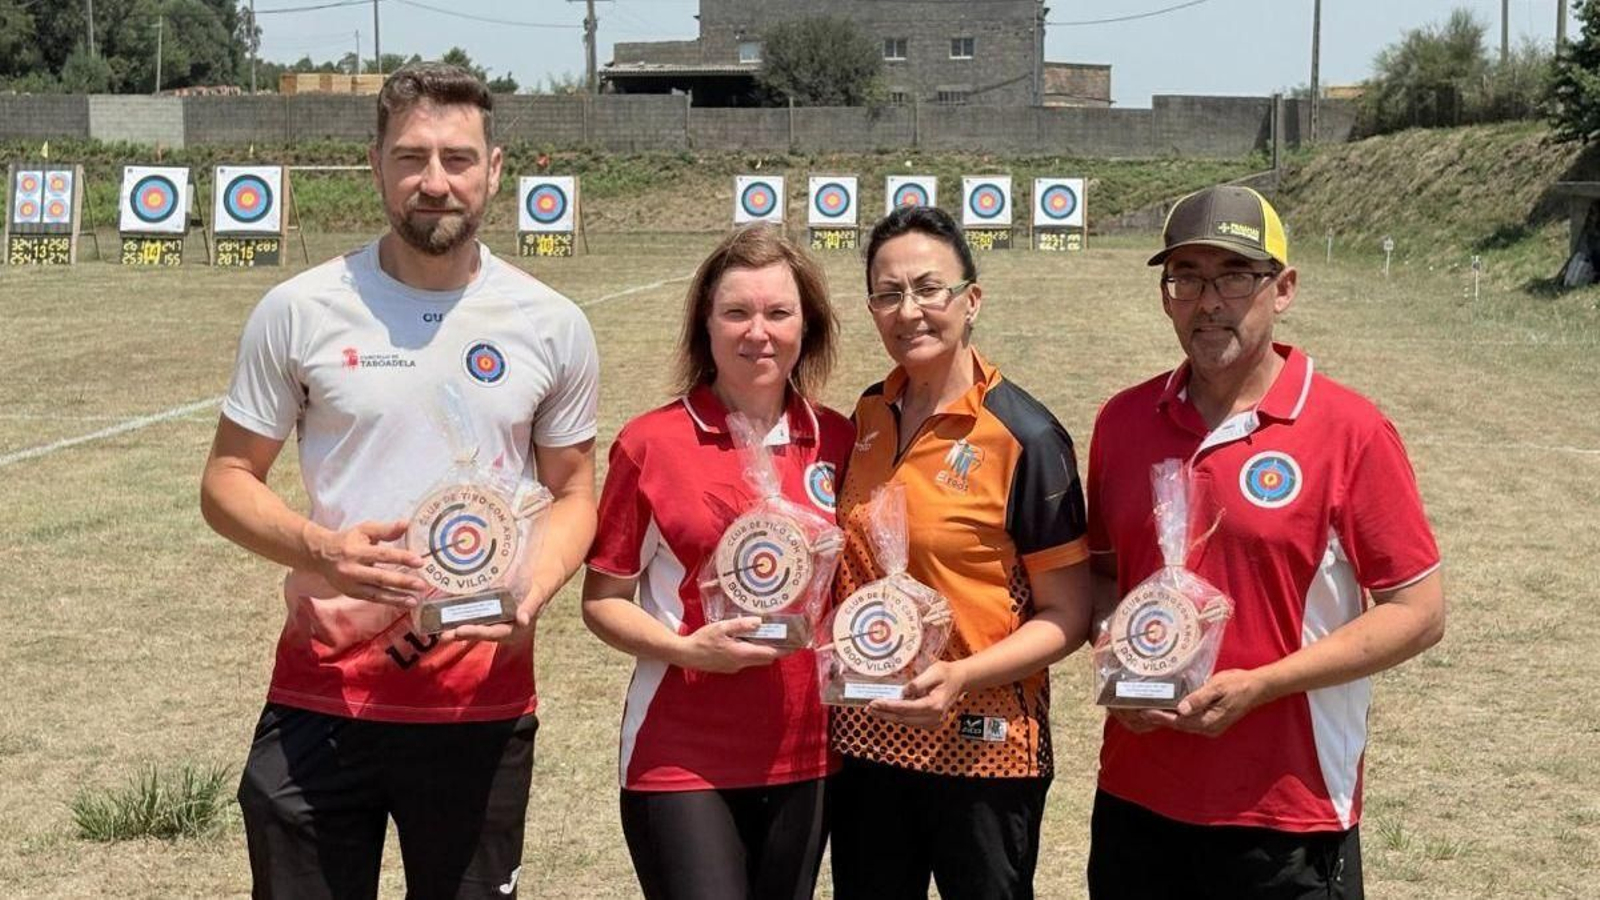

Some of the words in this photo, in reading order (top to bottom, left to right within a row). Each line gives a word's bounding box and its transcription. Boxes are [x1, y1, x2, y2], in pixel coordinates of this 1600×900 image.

[34, 244, 47, 258] 13
[240, 246, 254, 260] 15
[360, 360, 416, 368] TABOADELA
[500, 525, 512, 557] ARCO
[425, 563, 450, 587] BOA
[727, 581, 748, 604] BOA
